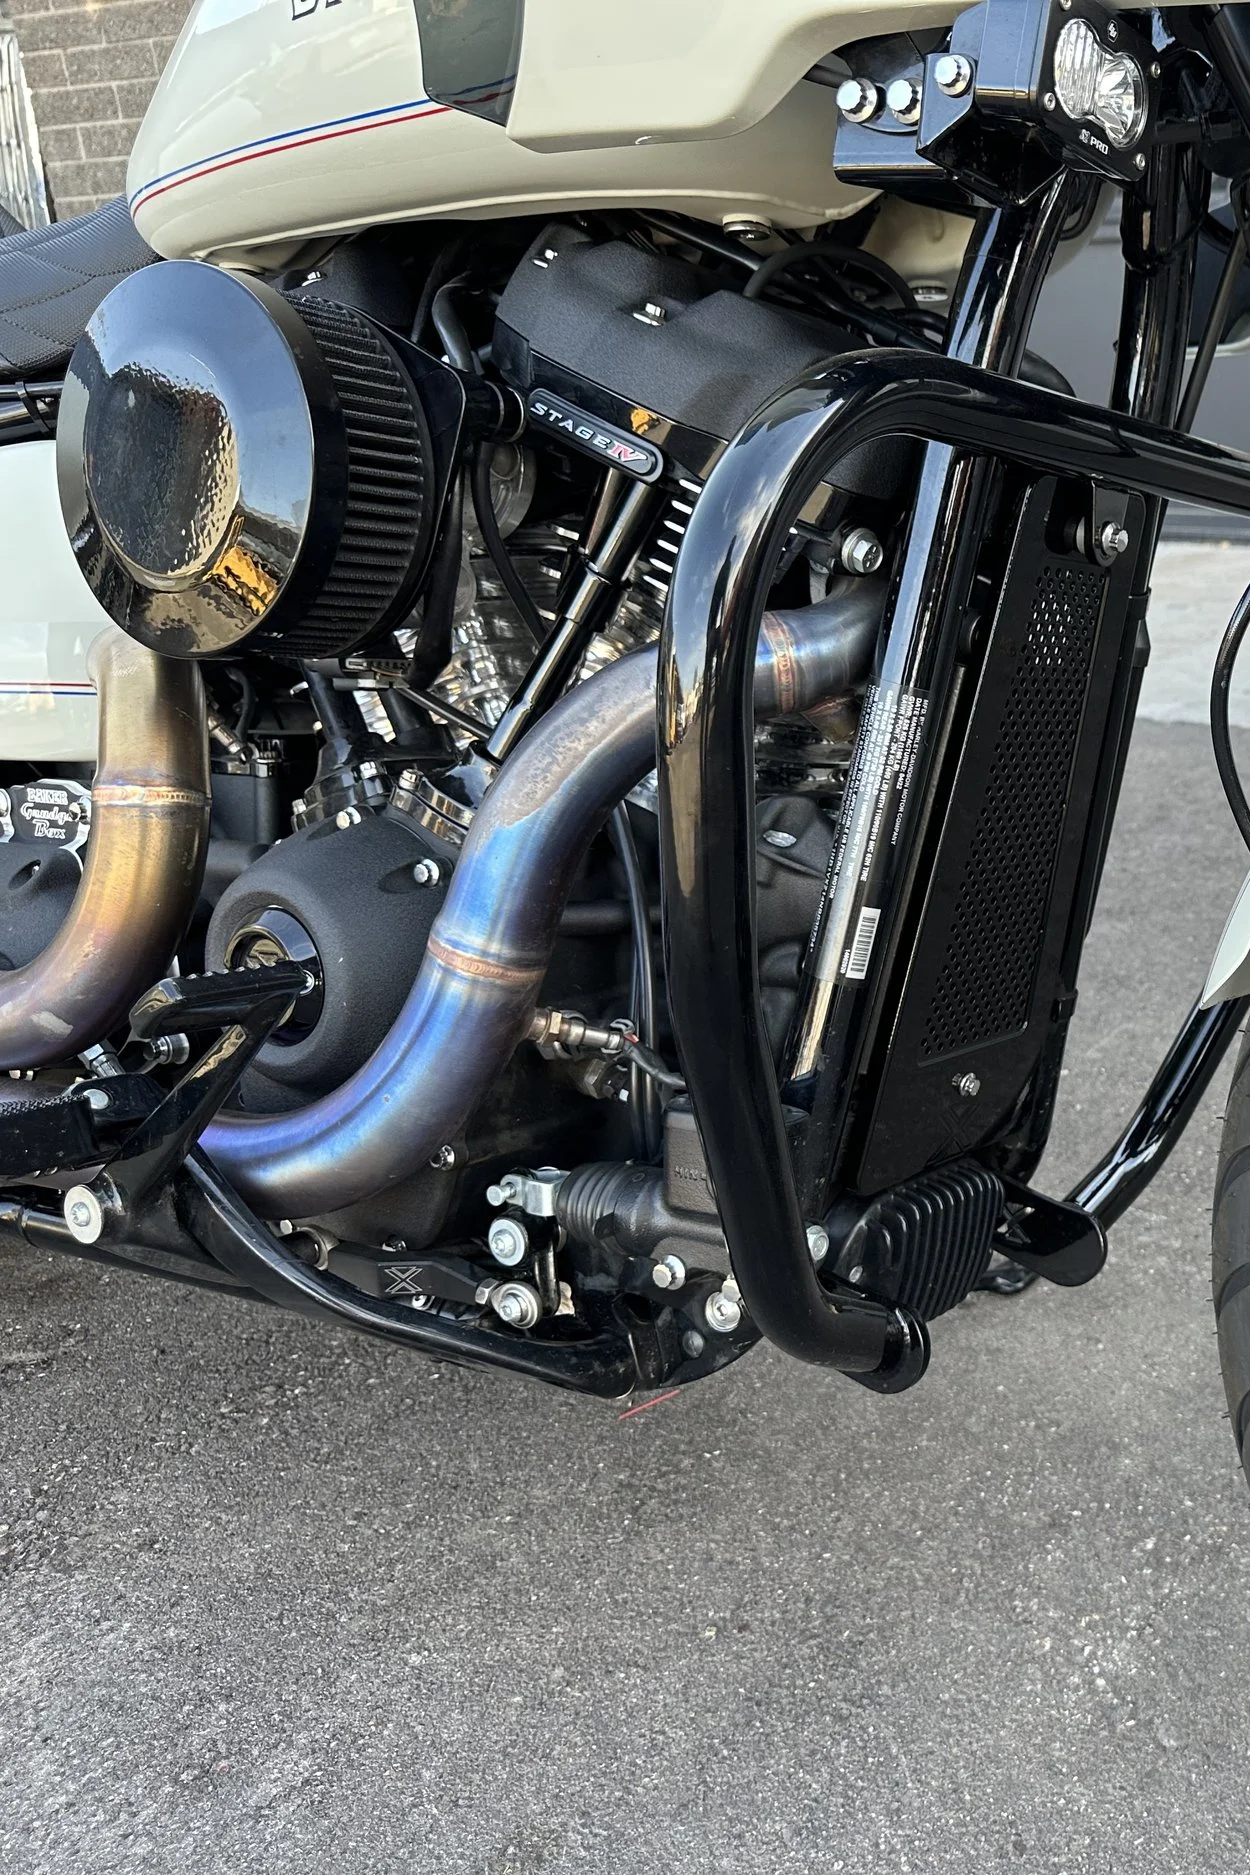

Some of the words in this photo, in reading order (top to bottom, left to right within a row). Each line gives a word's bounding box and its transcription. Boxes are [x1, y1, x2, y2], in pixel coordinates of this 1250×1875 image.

[1090, 135, 1109, 155] PRO
[530, 402, 612, 449] STAGE
[866, 701, 877, 731] VEHICLE
[912, 696, 922, 715] DATE
[892, 714, 904, 738] FRONT
[899, 715, 918, 773] MANUFACTURED:
[858, 772, 868, 792] COLD
[870, 775, 882, 796] COLD
[26, 787, 69, 806] BAKER
[876, 790, 886, 808] WITH
[897, 787, 909, 812] MOTOR
[32, 818, 67, 839] Box
[890, 812, 903, 845] COMPANY
[834, 843, 846, 874] FEDERAL
[860, 865, 870, 882] TIRE
[828, 874, 839, 899] MOTOR
